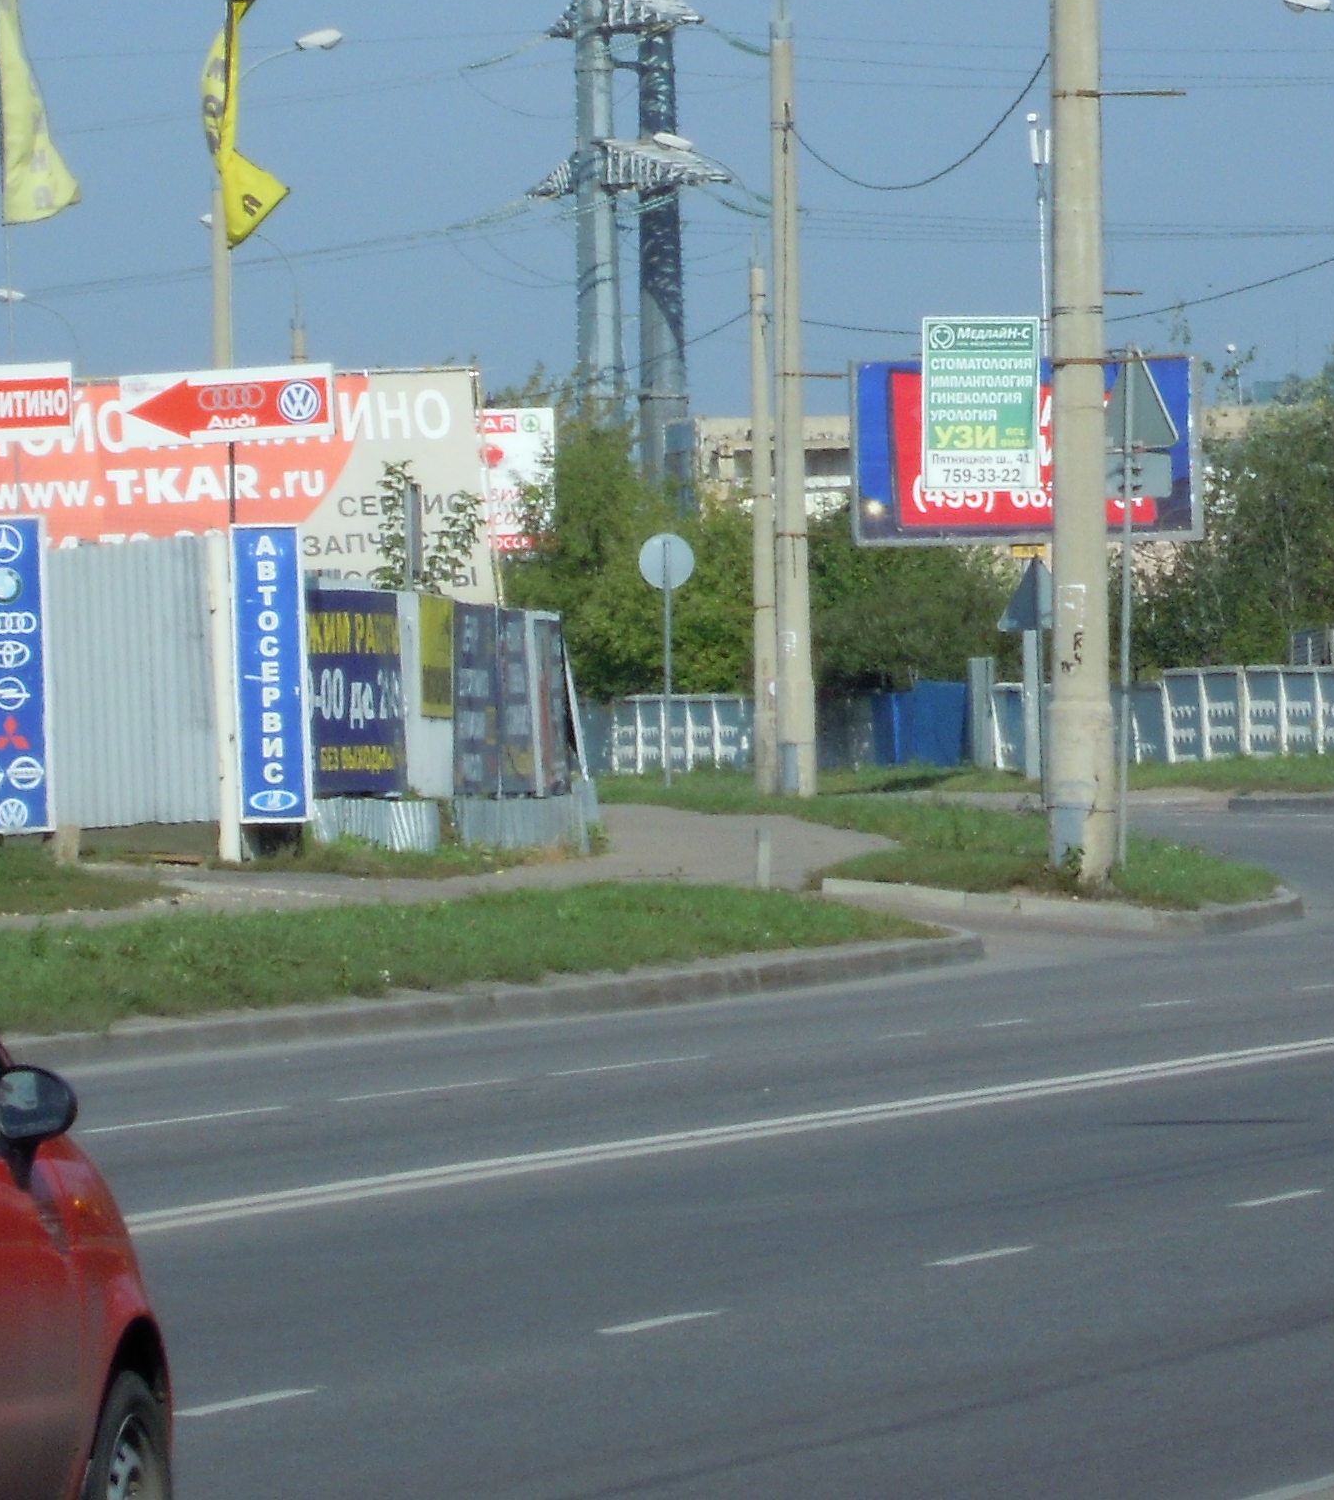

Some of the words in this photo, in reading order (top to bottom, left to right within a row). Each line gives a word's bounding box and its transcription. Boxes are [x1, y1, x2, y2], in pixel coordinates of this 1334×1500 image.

[931, 359, 1032, 370] СТОМАТОЛОГИЯ
[931, 376, 1032, 388] ИМПЛАНТОЛОГИЯ
[931, 393, 1022, 404] ГИНЕКОЛОГИЯ
[207, 414, 256, 429] Audi
[930, 409, 998, 421] УРОЛОГИЯ
[934, 425, 997, 449] УЗИ
[932, 453, 993, 464] Пятницкое
[1017, 453, 1030, 463] 41
[943, 468, 1021, 483] 759-33-22
[338, 492, 469, 518] СЕРИС
[255, 535, 284, 784] АВТОСЕРВИС
[350, 682, 375, 730] до
